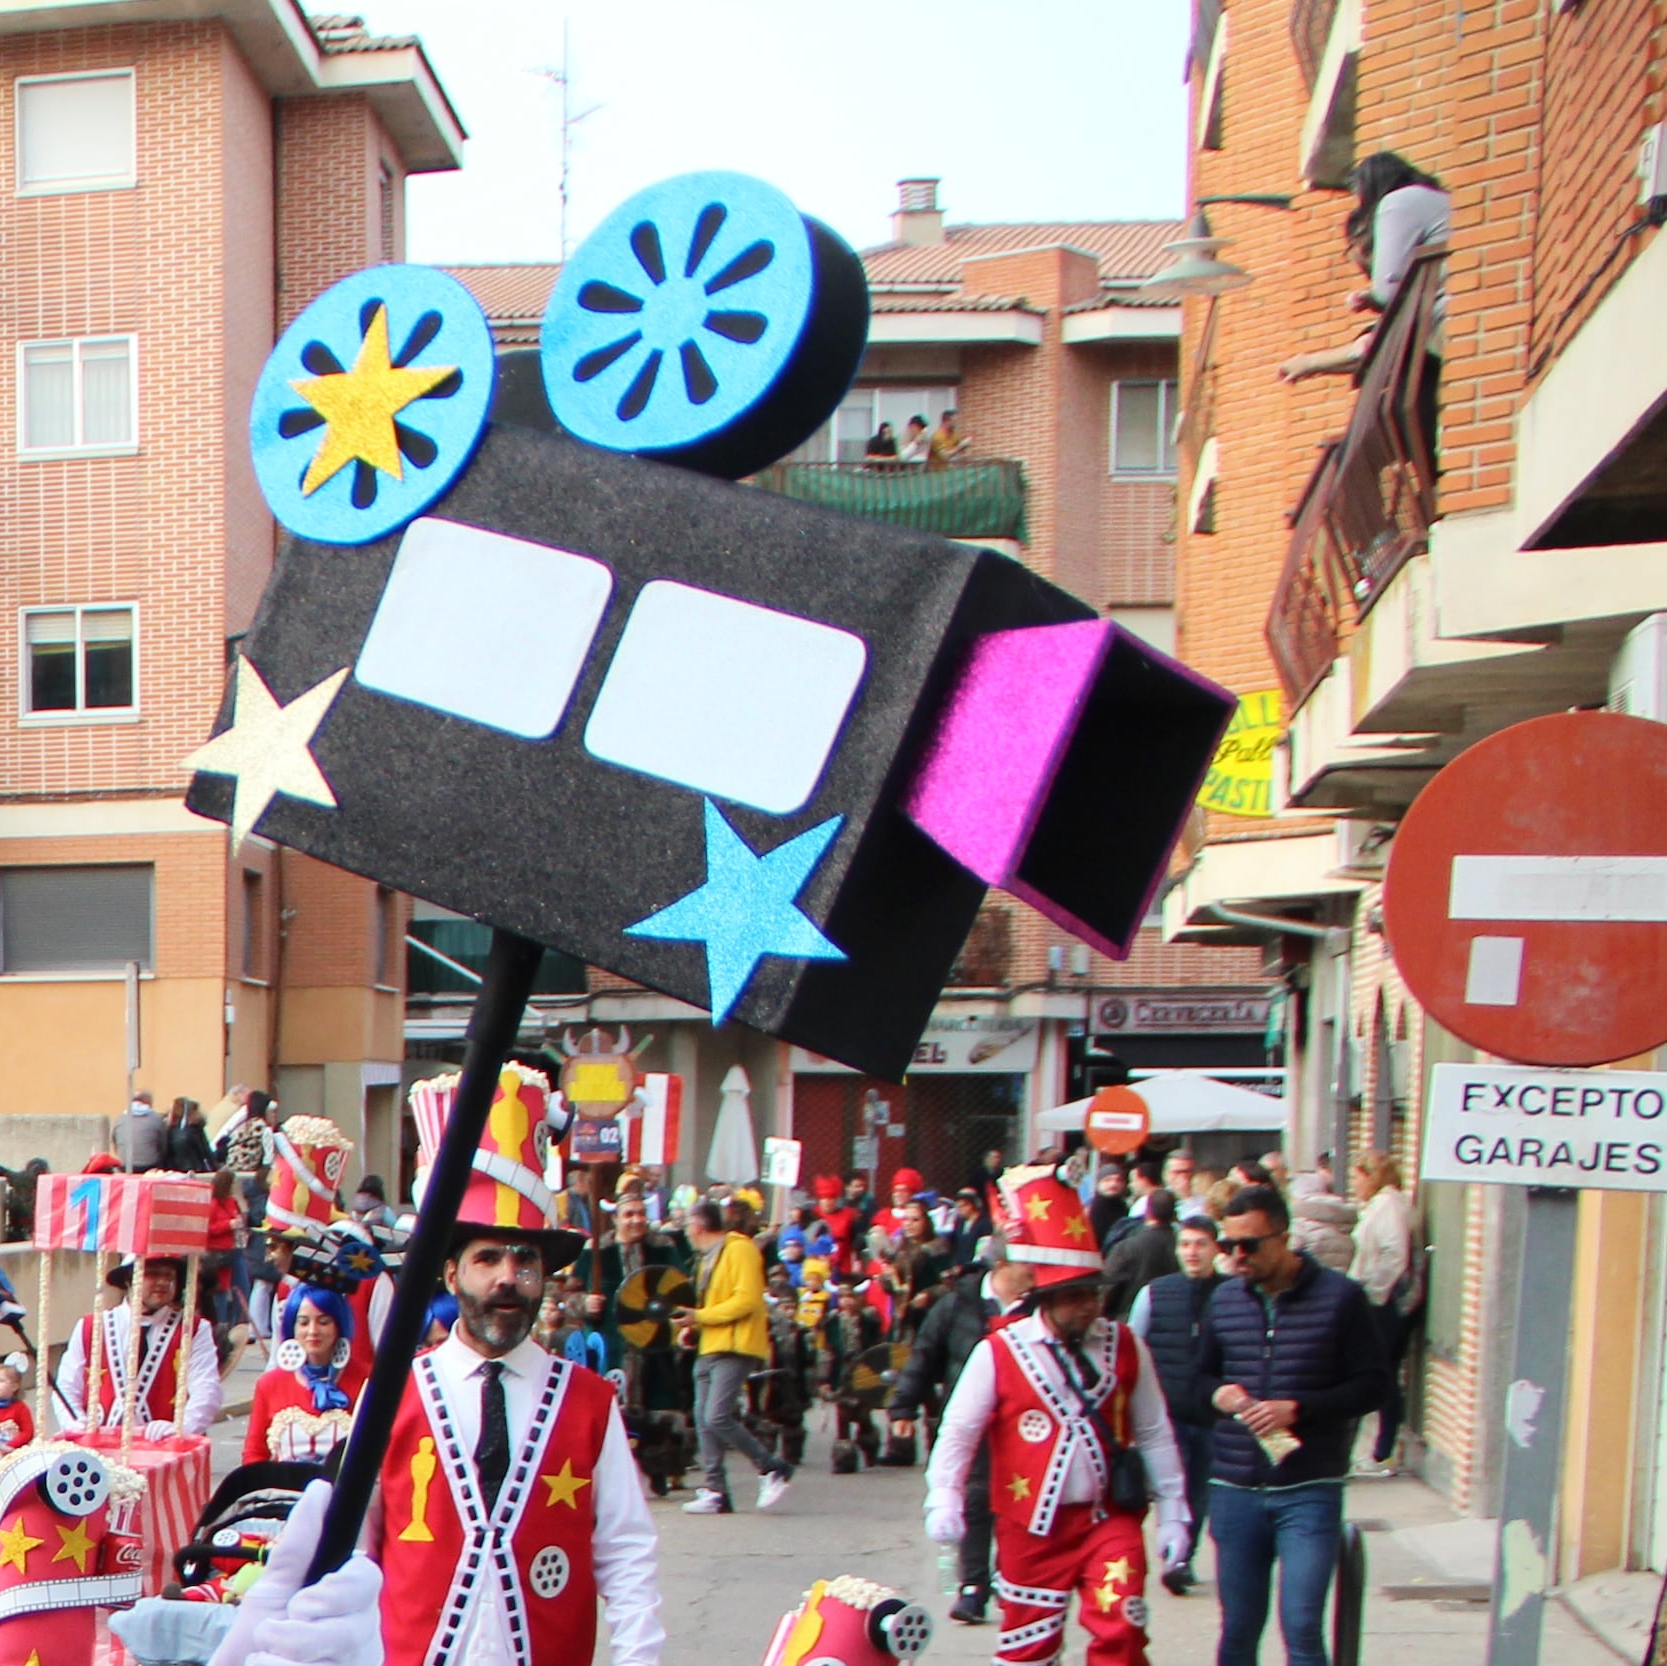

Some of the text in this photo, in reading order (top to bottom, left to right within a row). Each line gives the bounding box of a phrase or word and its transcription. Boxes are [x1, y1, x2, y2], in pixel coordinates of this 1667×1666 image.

[599, 1127, 619, 1143] 02
[1454, 1134, 1662, 1175] GARAJES
[70, 1178, 101, 1251] 1
